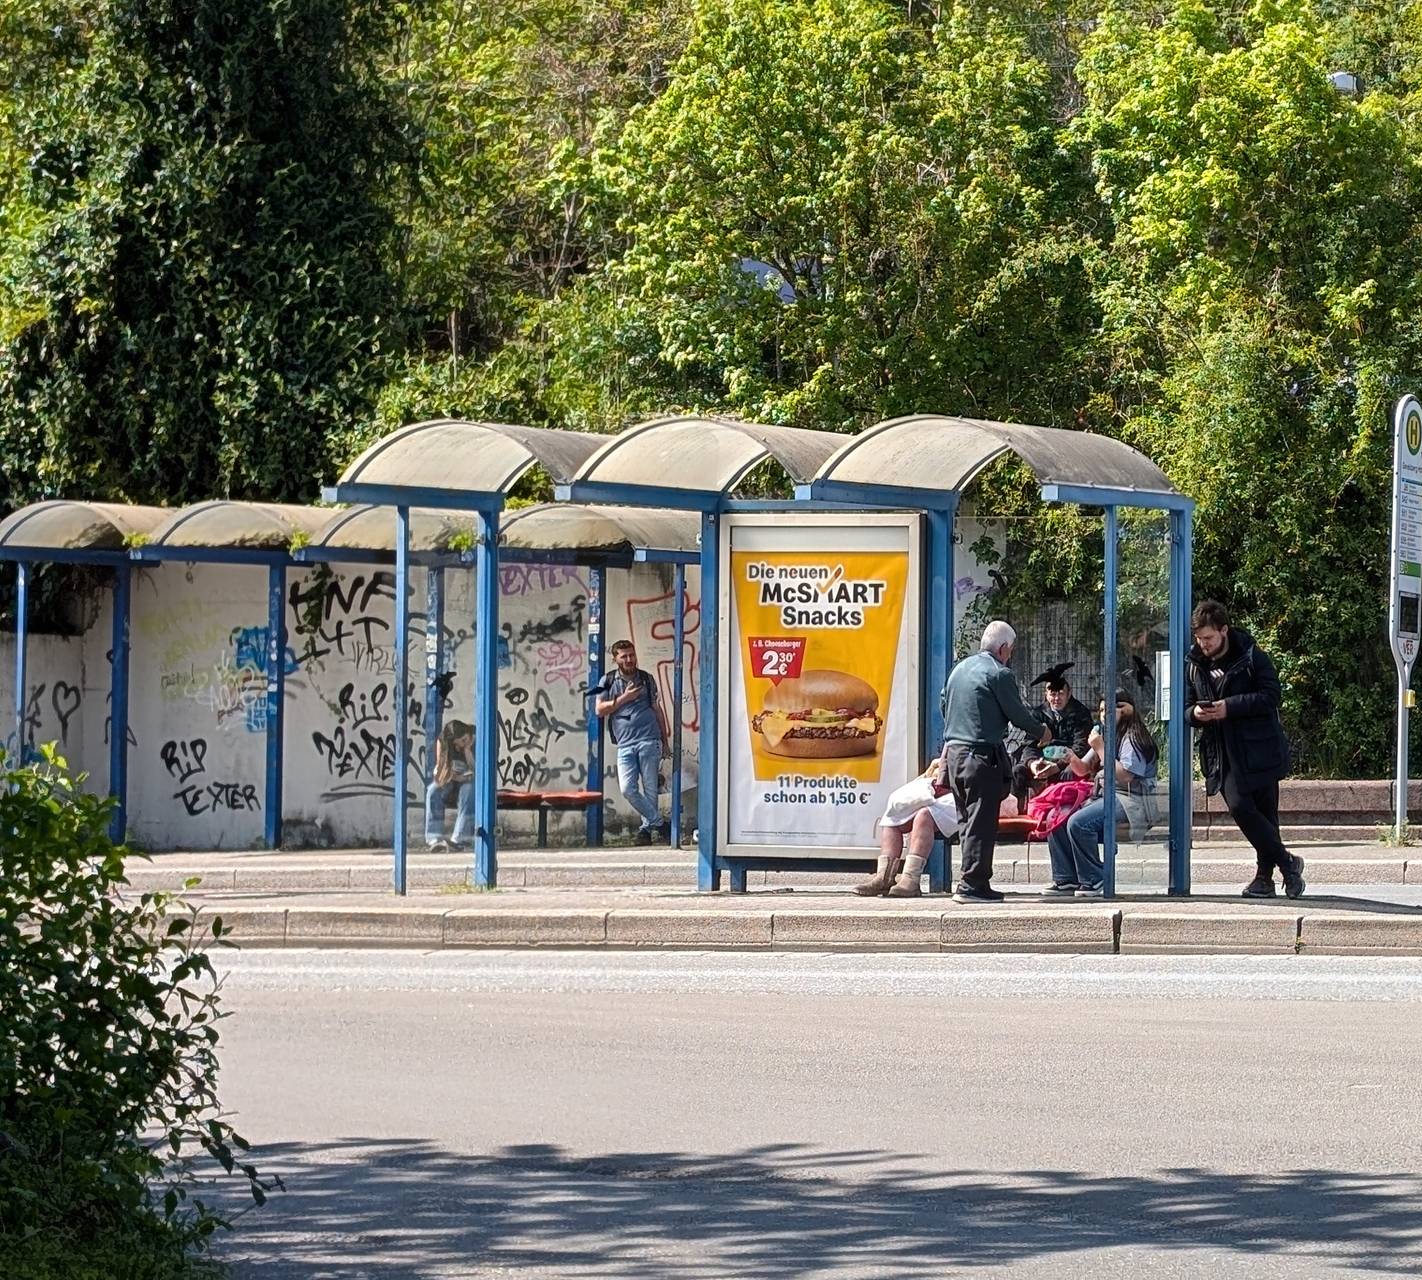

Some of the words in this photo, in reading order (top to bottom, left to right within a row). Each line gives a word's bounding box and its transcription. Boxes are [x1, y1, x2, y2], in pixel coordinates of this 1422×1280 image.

[749, 565, 774, 579] Die
[779, 567, 828, 579] neuen
[761, 583, 884, 604] McSMART
[783, 606, 862, 626] Snacks
[778, 777, 790, 787] 11
[795, 777, 857, 789] Produkte
[764, 791, 806, 803] schon
[809, 792, 827, 804] ab
[830, 793, 856, 806] 1,50
